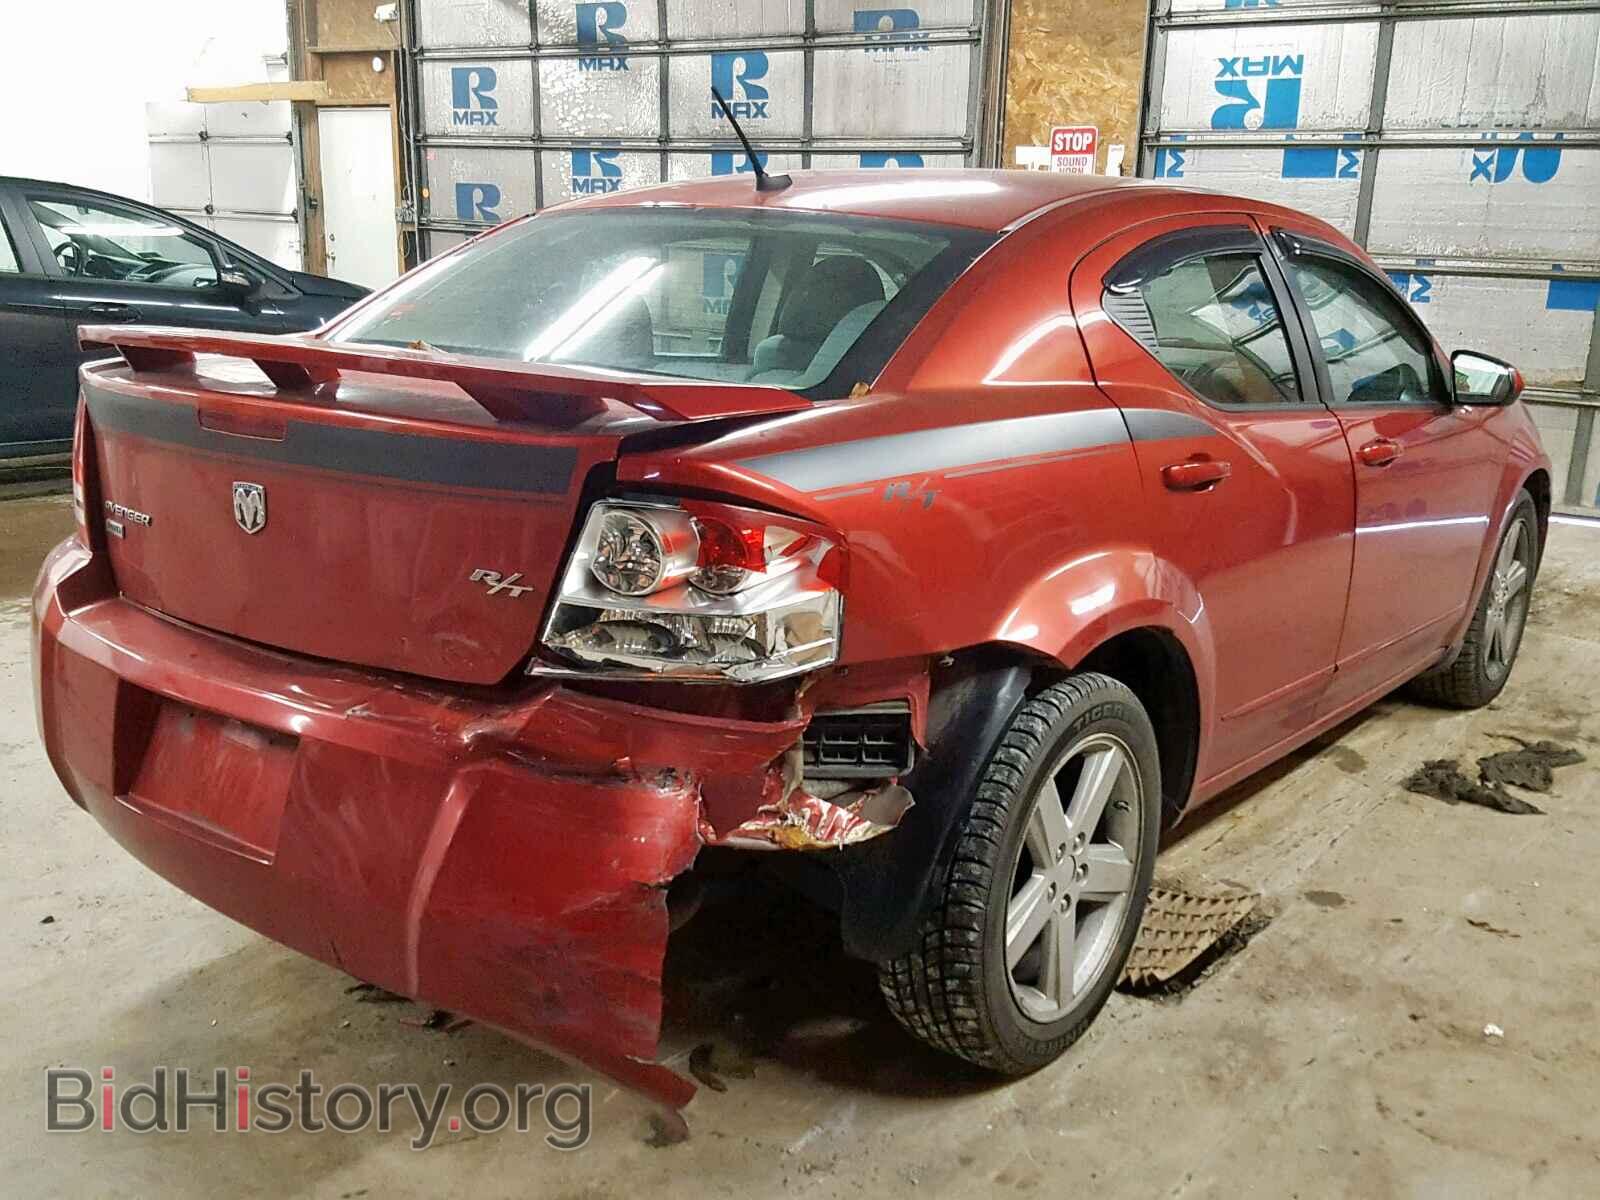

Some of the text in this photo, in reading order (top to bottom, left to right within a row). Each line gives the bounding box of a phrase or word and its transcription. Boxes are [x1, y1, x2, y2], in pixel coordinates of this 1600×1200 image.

[578, 57, 630, 71] MAX
[1216, 54, 1304, 77] MAX
[451, 67, 498, 109] R
[453, 111, 498, 126] MAX
[711, 102, 769, 119] MAX
[1053, 132, 1093, 152] STOP
[1056, 156, 1088, 166] SOUND
[572, 178, 622, 194] MAX
[104, 500, 151, 528] AVENGER
[469, 568, 535, 598] R/T
